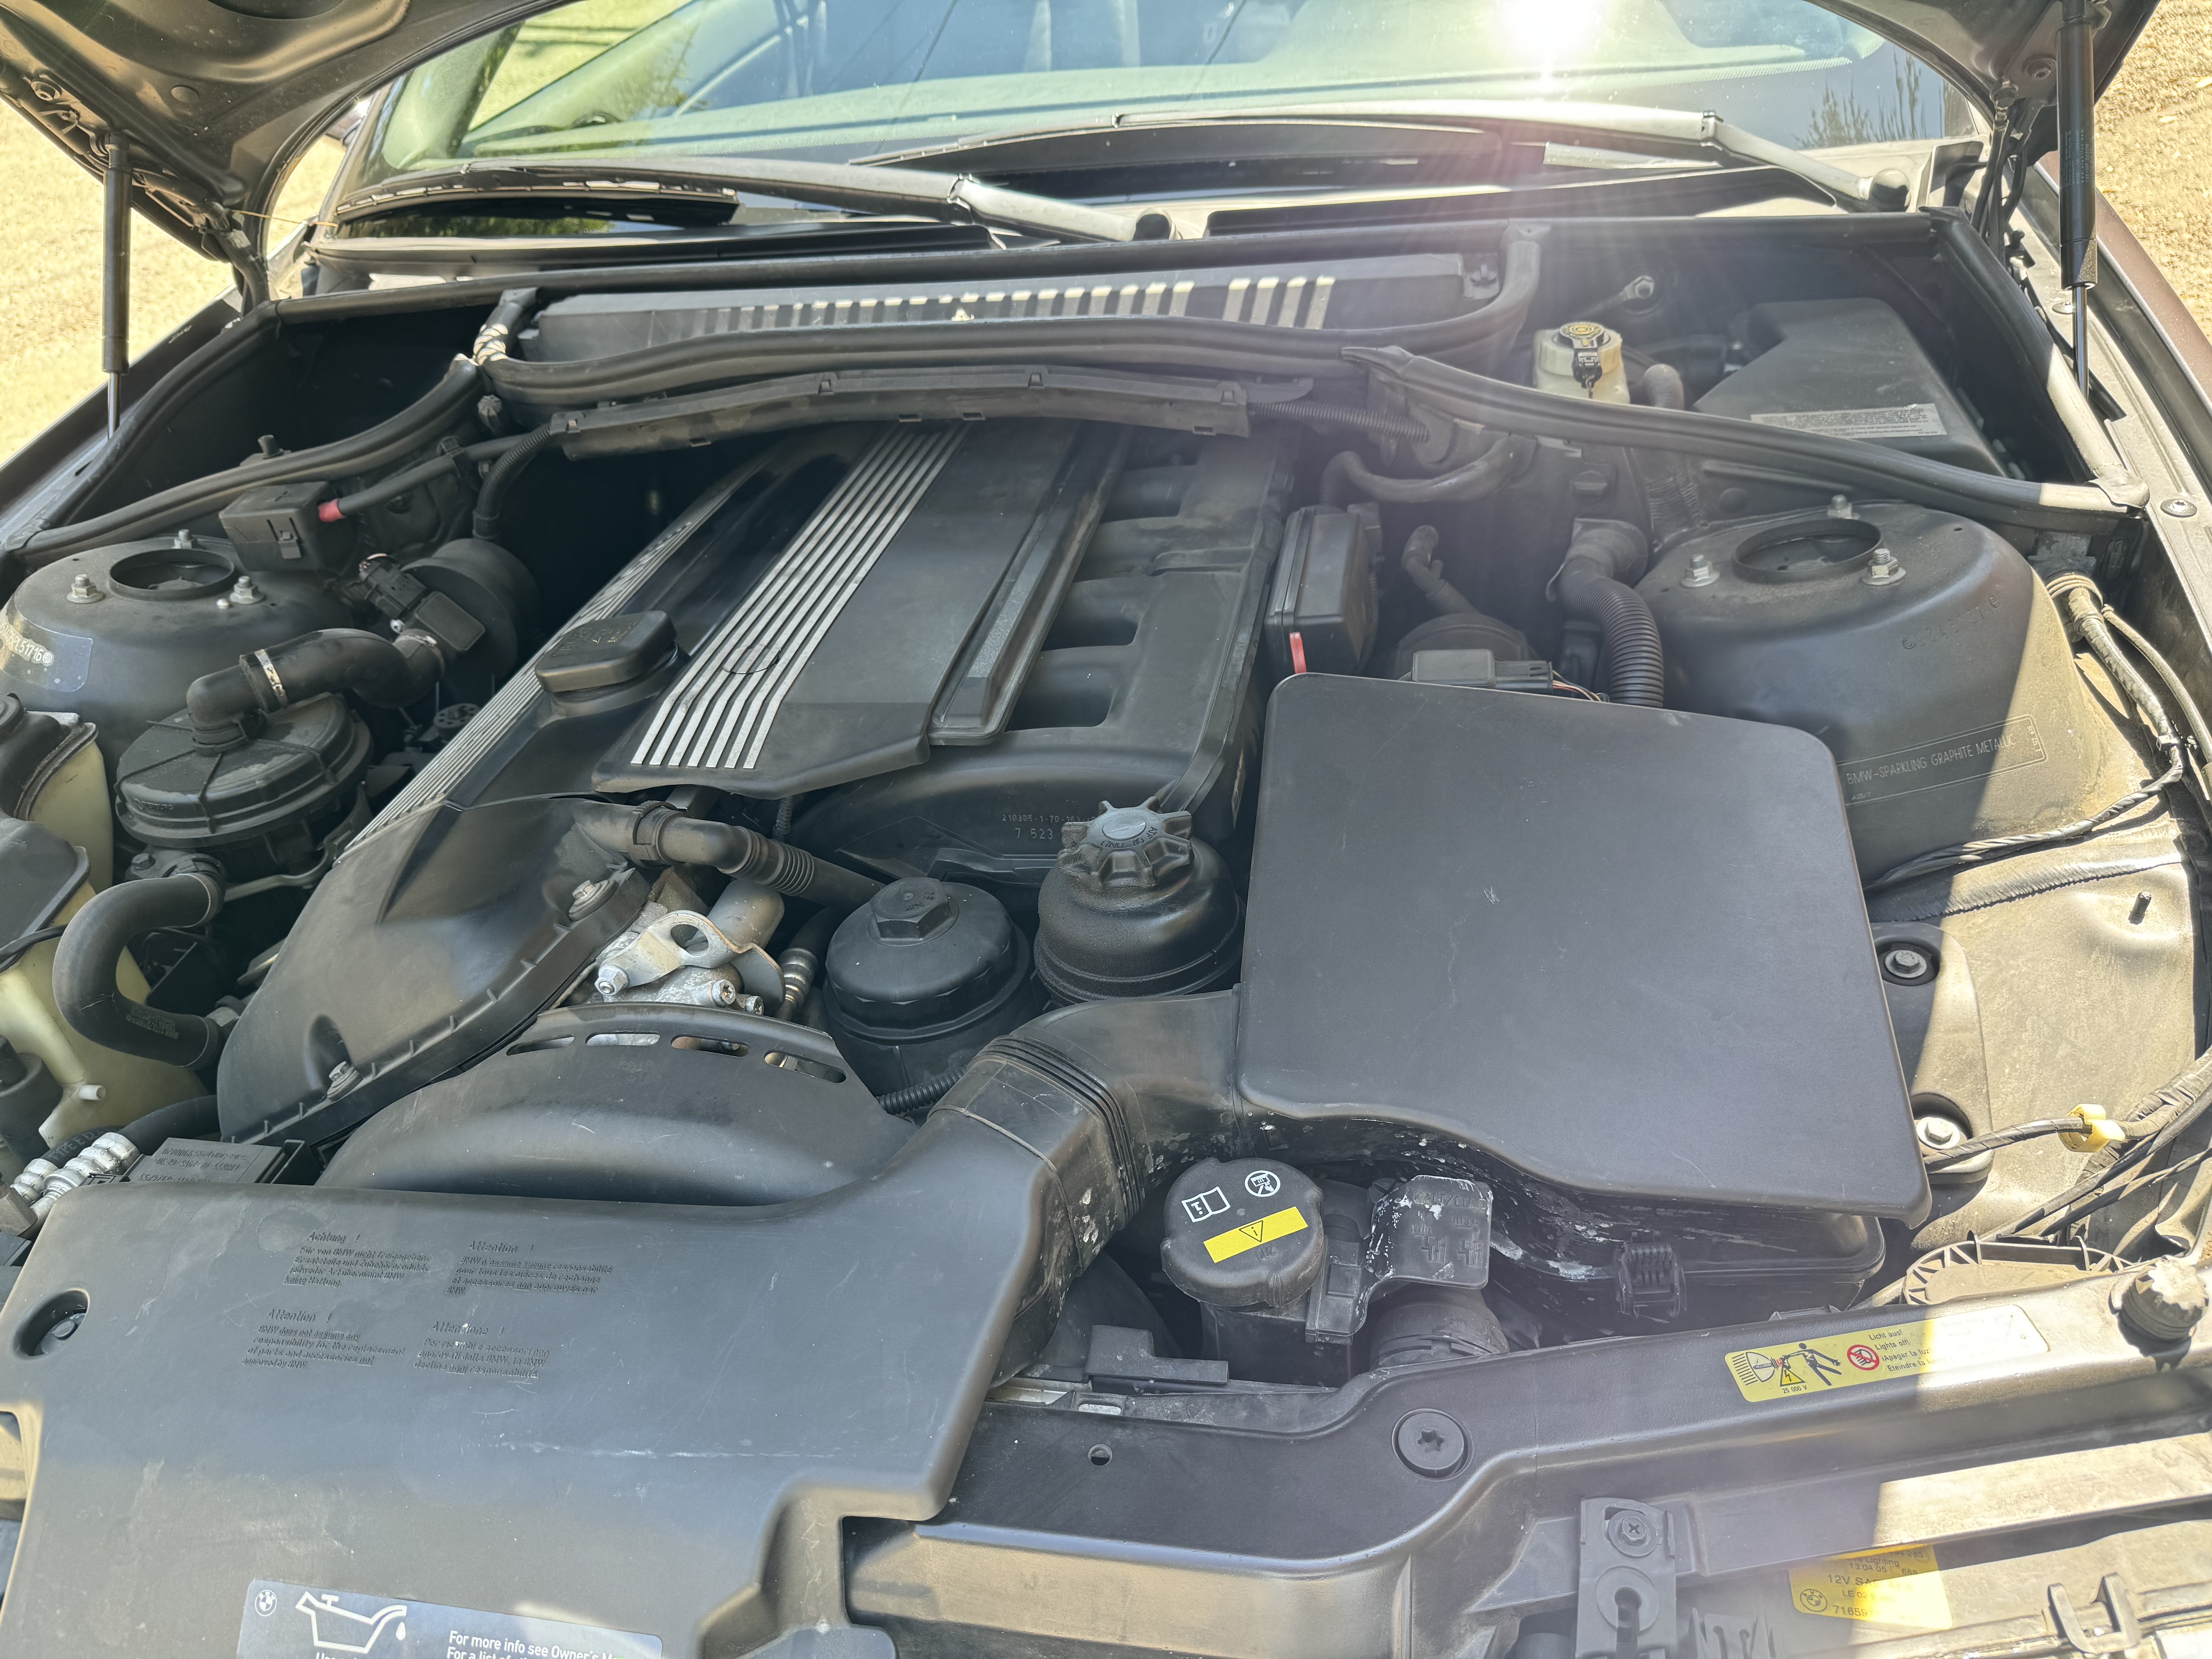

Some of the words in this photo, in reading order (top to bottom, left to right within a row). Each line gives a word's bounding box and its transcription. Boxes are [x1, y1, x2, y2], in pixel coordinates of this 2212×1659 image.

[1846, 757, 1927, 785] BMW-SPARKLING
[1930, 745, 1973, 766] GRAPHITE
[1976, 733, 2016, 755] METALLIC
[1015, 828, 1020, 838] 7
[1030, 828, 1053, 839] 523
[1146, 826, 1158, 839] ATF
[307, 1231, 346, 1244] Achtung
[468, 1241, 518, 1253] Attention
[266, 1309, 316, 1322] Attention
[258, 1325, 279, 1334] BMW
[279, 1326, 297, 1336] does
[313, 1331, 345, 1339] assume
[346, 1334, 361, 1343] any
[431, 1321, 488, 1335] Attenzione
[1888, 1329, 1903, 1338] aus!
[253, 1337, 314, 1349] responsibility
[316, 1339, 330, 1348] for
[332, 1341, 347, 1350] the
[347, 1344, 406, 1356] replacement
[1875, 1342, 1897, 1351] Lights
[285, 1350, 302, 1358] and
[302, 1352, 358, 1362] accessories
[359, 1356, 374, 1364] not
[1887, 1362, 1917, 1372] Eteindre
[1865, 1556, 1899, 1567] Lighting
[1828, 1574, 1850, 1585] 12V
[449, 1630, 469, 1645] For
[471, 1637, 501, 1650] more
[504, 1638, 525, 1653] info
[527, 1645, 548, 1657] see
[447, 1646, 467, 1659] For
